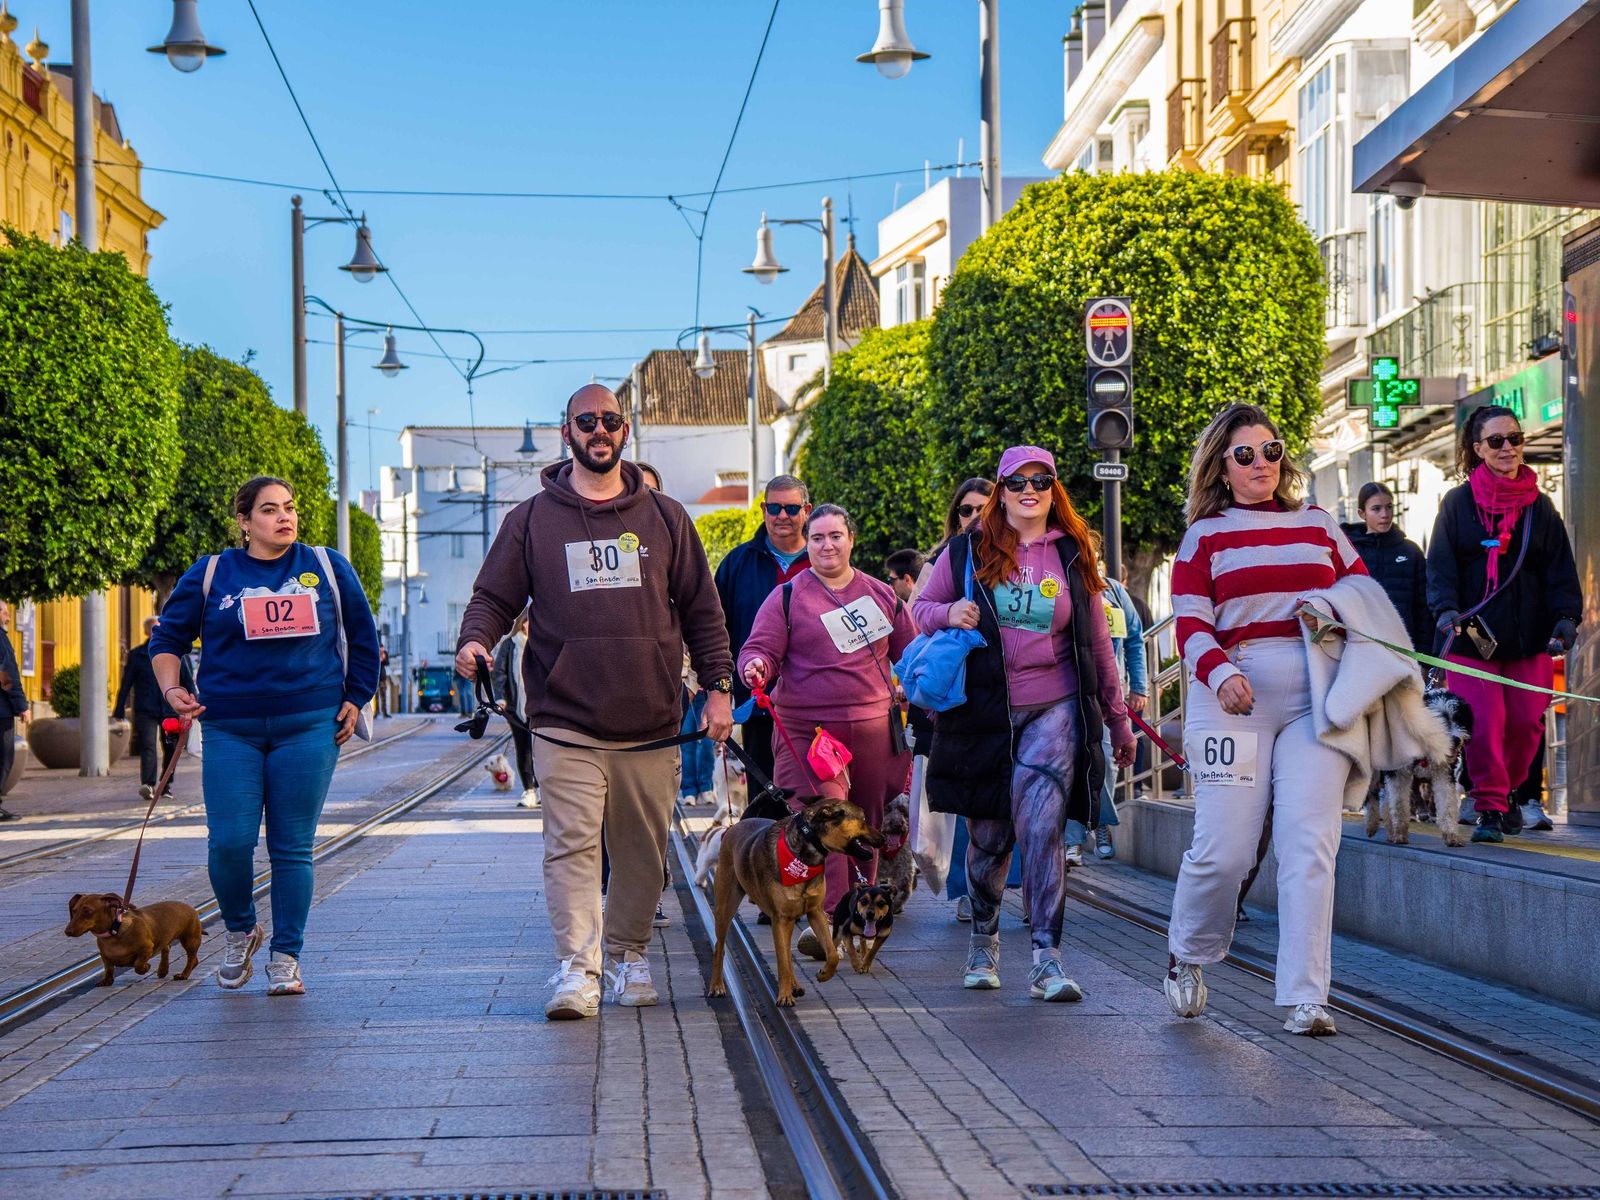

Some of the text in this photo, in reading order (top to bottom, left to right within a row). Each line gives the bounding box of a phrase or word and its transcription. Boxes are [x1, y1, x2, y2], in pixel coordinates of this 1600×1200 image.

[588, 545, 619, 572] 30
[585, 576, 598, 585] San
[1008, 587, 1034, 614] 31
[265, 600, 295, 623] 02
[998, 614, 1010, 622] San
[274, 625, 296, 633] Antón
[840, 609, 868, 633] 05
[847, 637, 858, 645] San
[1204, 736, 1235, 766] 60
[1200, 771, 1234, 780] San Antón
